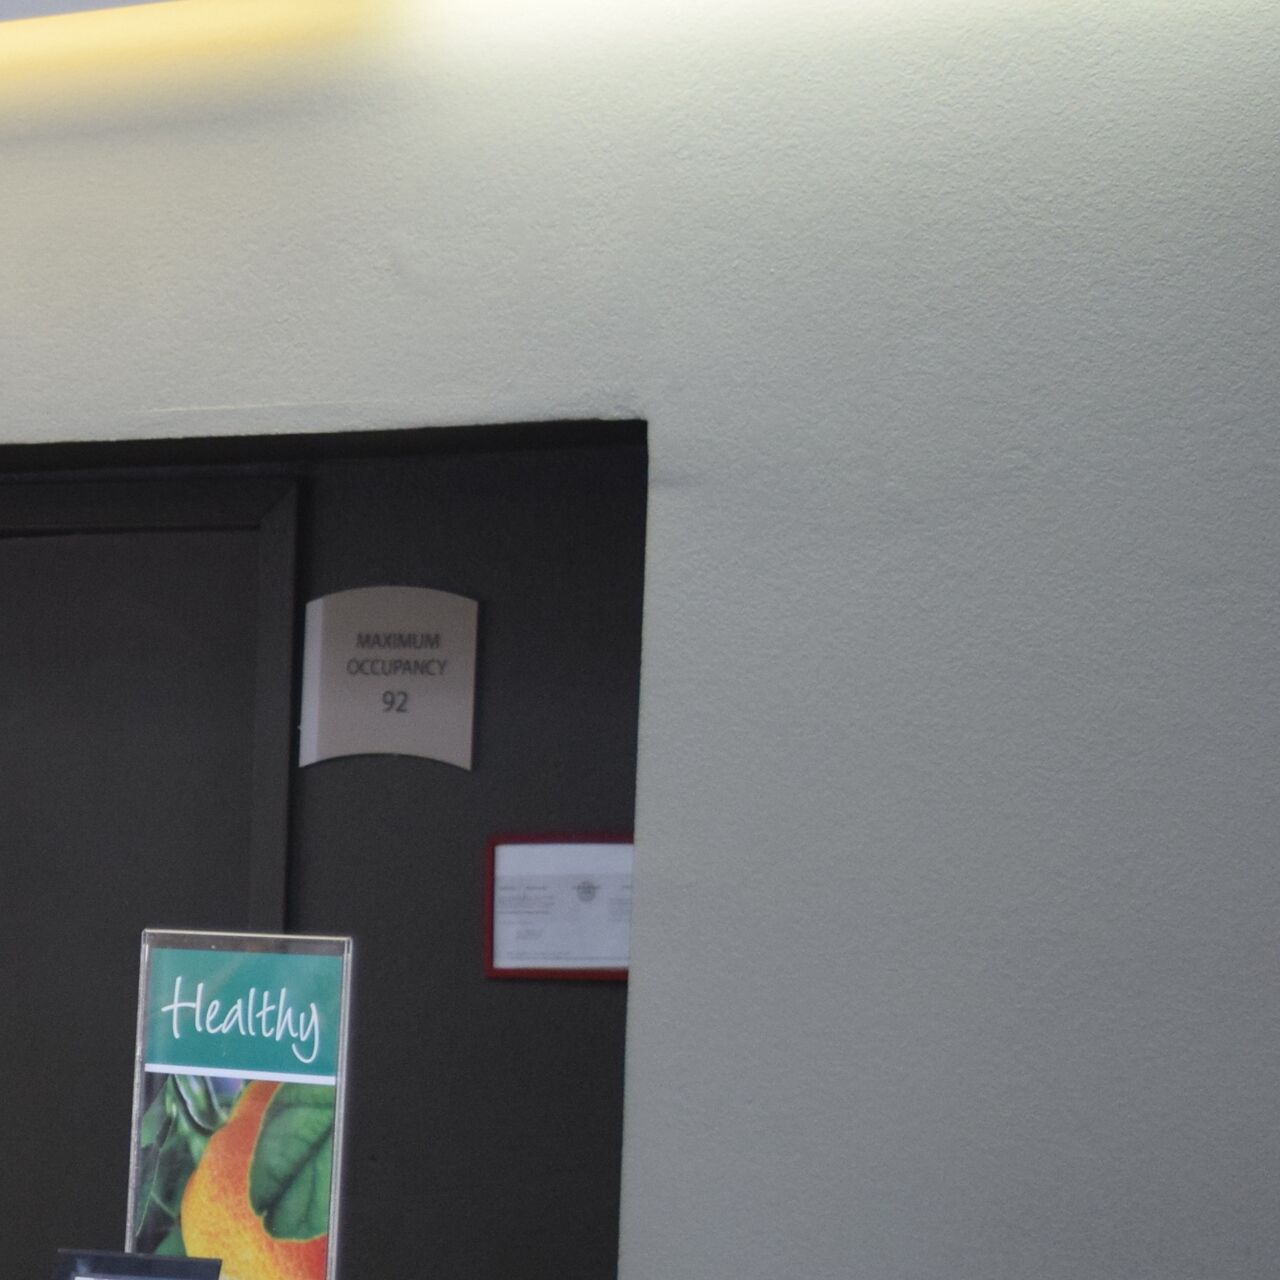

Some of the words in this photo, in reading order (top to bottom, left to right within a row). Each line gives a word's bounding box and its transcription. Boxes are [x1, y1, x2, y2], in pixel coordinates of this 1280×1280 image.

[356, 633, 441, 649] MAXIMUM
[345, 658, 448, 676] OCCUPANCY
[382, 690, 409, 713] 92
[161, 975, 320, 1063] Healthy
